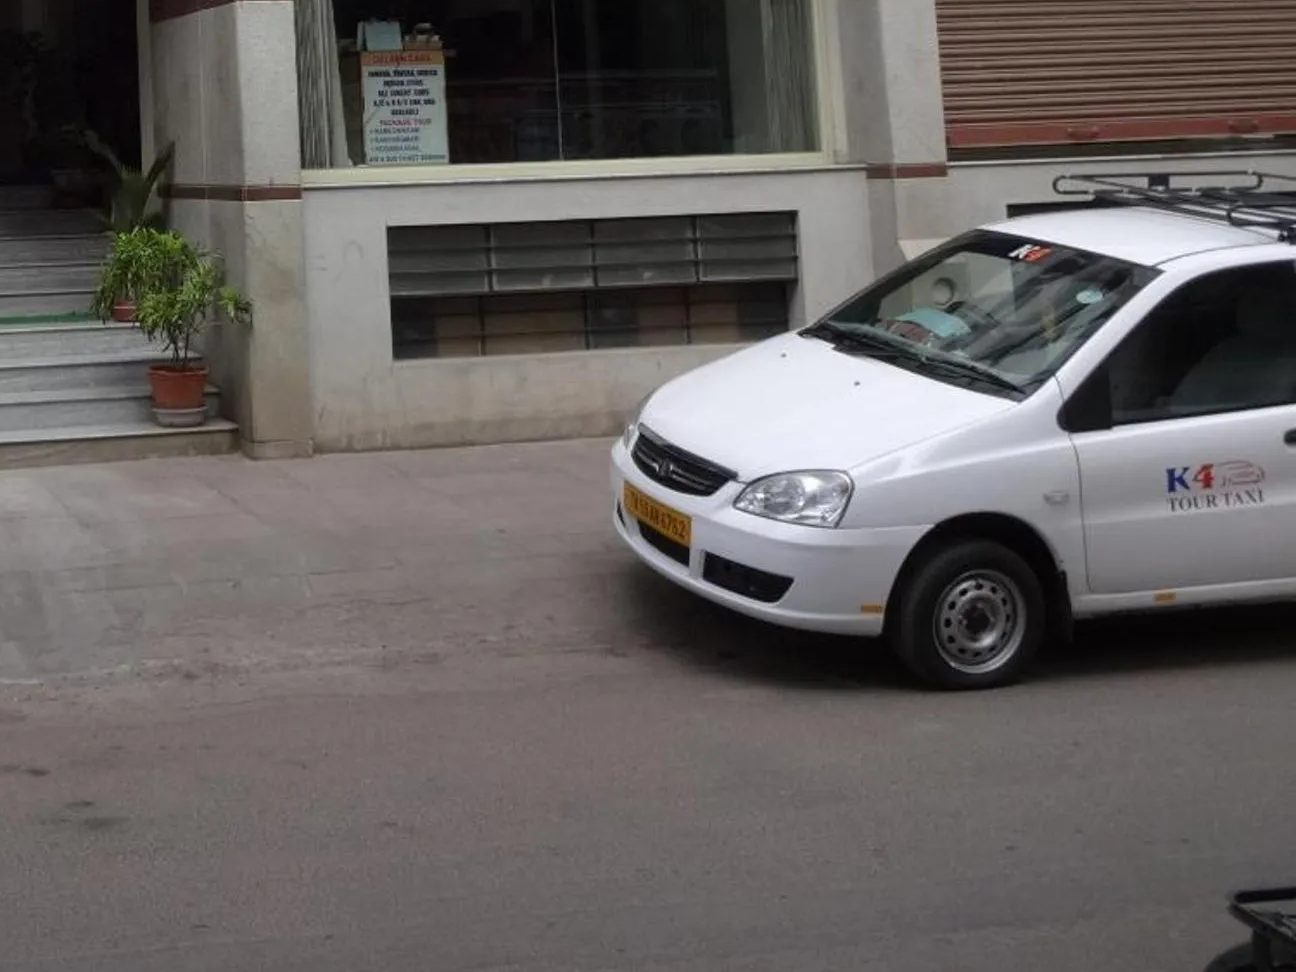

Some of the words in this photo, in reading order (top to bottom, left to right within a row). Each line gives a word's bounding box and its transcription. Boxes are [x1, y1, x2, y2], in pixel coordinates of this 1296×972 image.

[1166, 463, 1215, 493] K4
[1167, 494, 1218, 512] TOUR
[1220, 488, 1265, 507] TAXI
